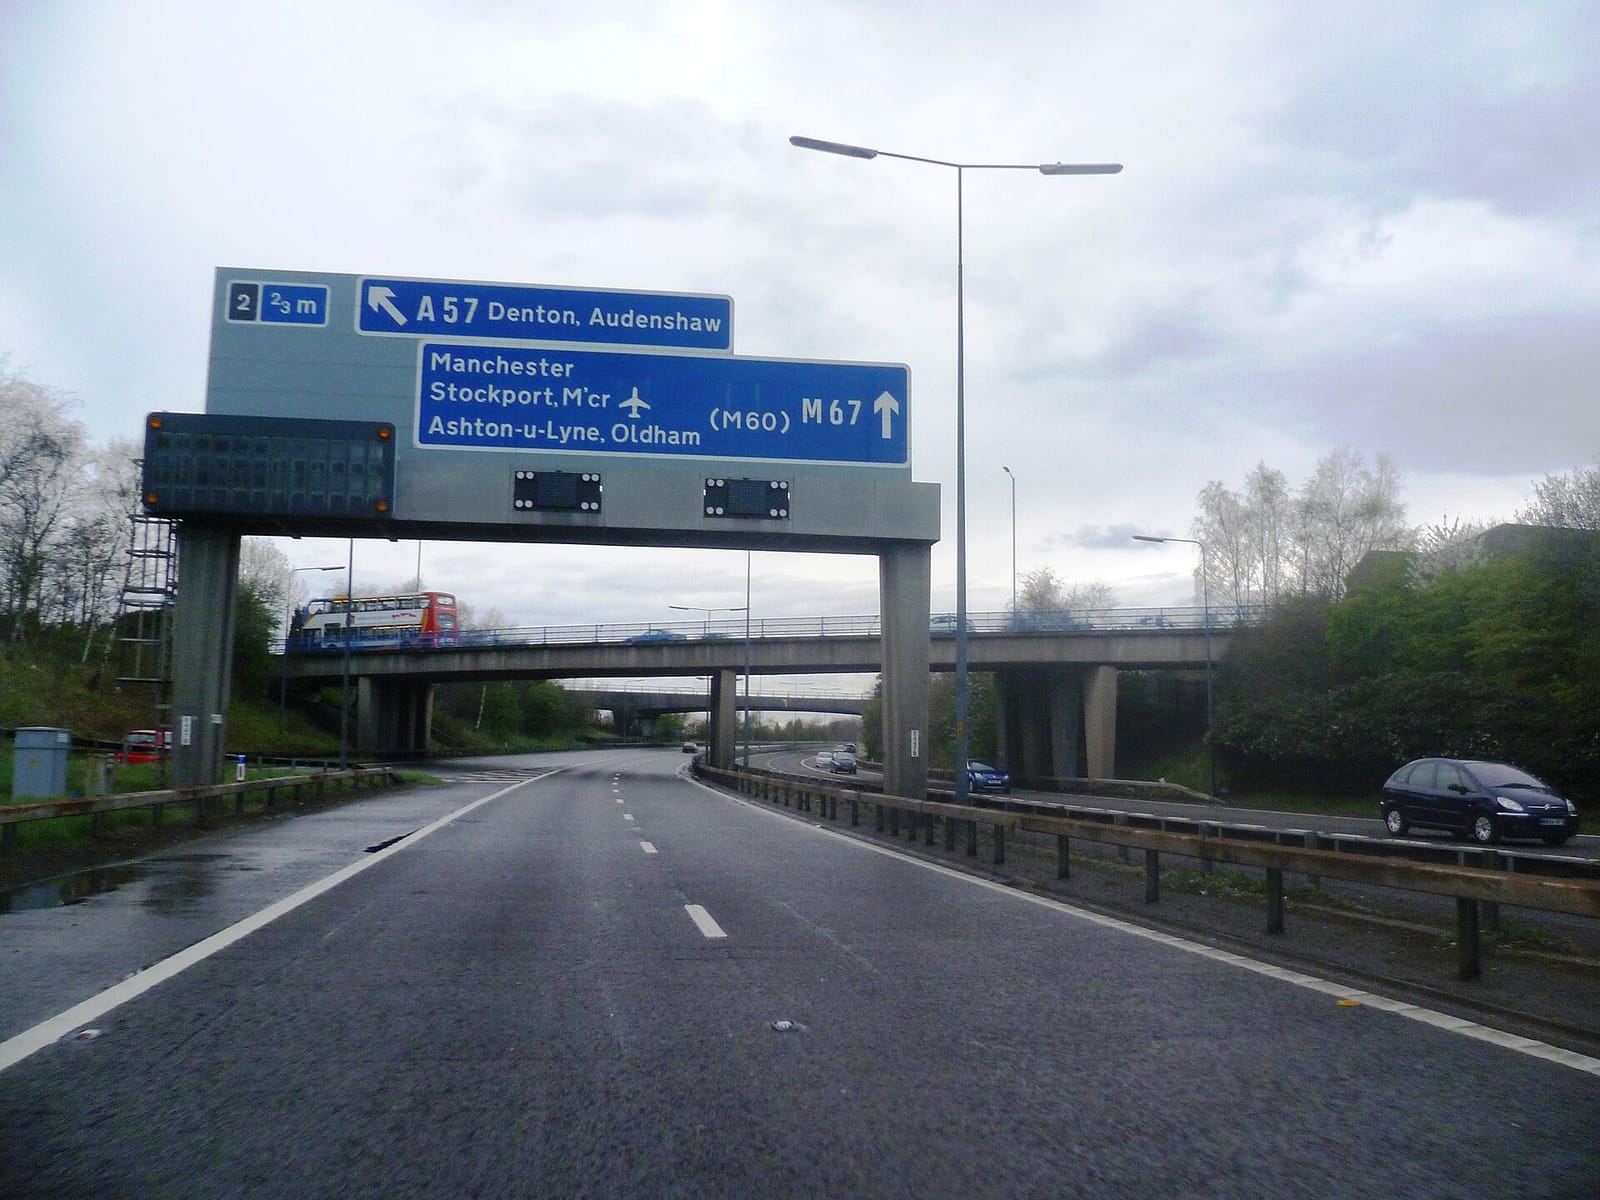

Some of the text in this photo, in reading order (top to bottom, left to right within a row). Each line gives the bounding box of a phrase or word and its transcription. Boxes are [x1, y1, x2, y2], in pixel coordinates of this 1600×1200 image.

[237, 294, 250, 311] 2
[488, 302, 580, 326] Denton,
[589, 307, 722, 332] Audenshaw
[431, 352, 575, 377] Manchester
[430, 381, 559, 407] Stockport,
[428, 415, 701, 445] Ashton-u-Lyne, Oldham
[710, 398, 862, 434] (M60) M67
